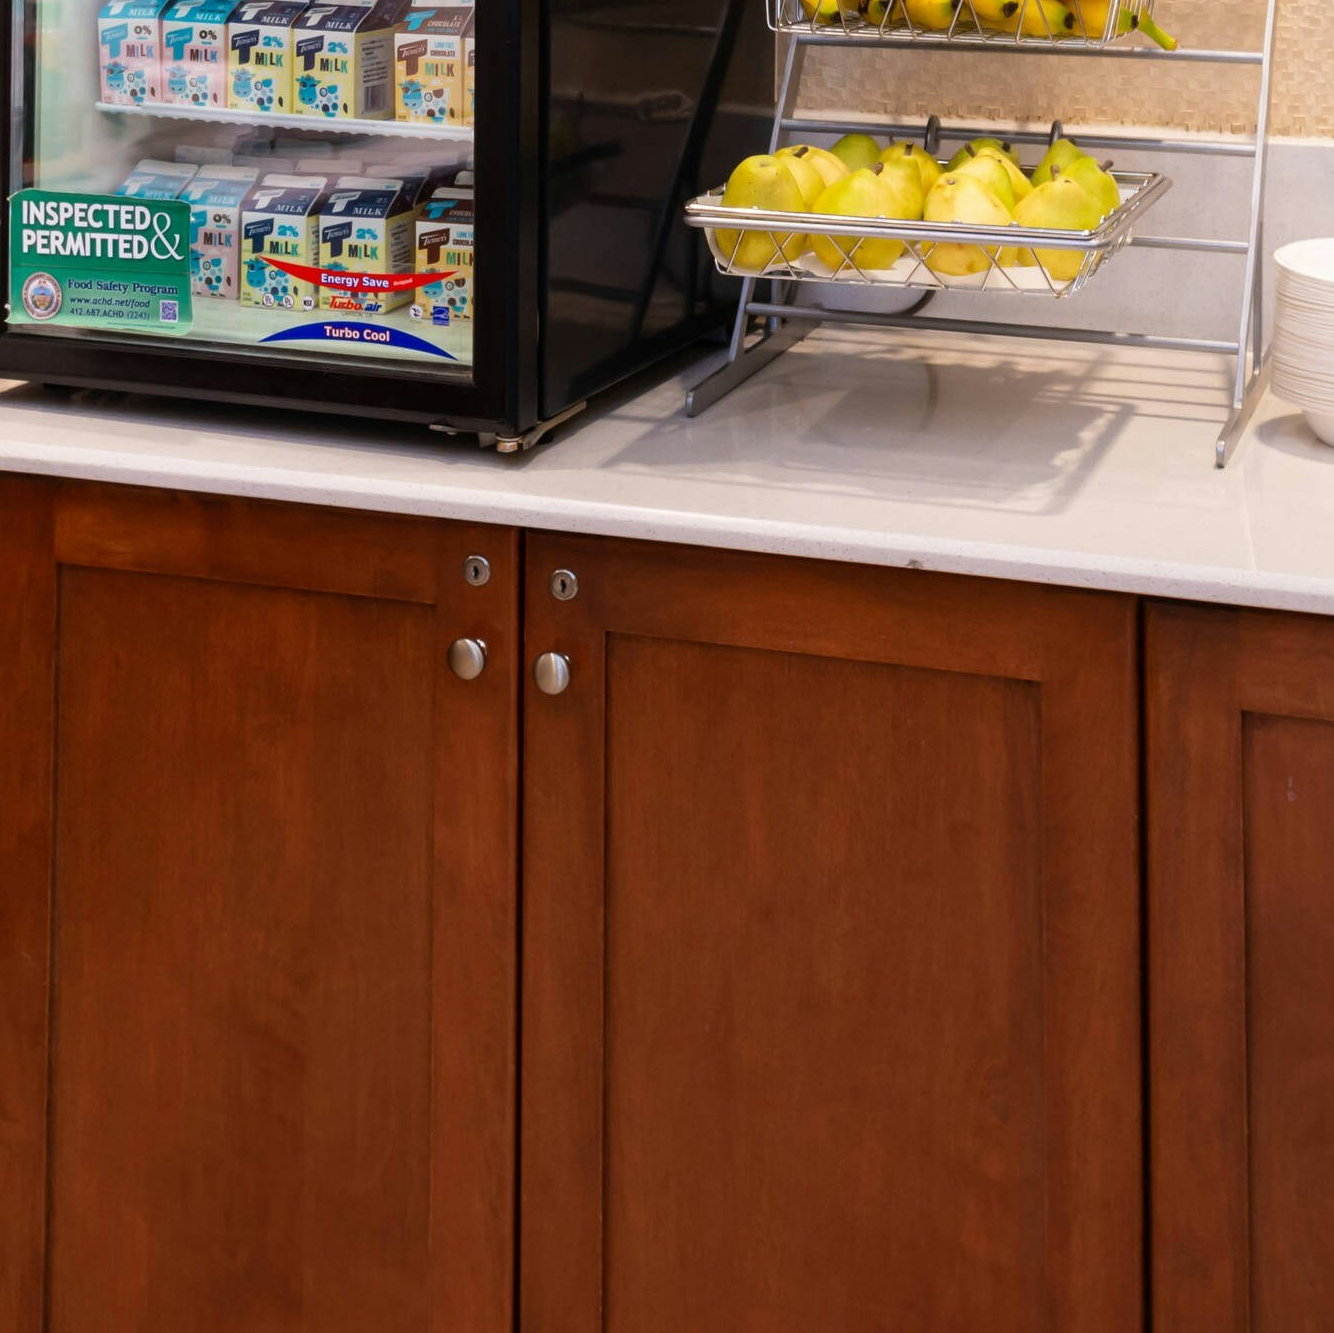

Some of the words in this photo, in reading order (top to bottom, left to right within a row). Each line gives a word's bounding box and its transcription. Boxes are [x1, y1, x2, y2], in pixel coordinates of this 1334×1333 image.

[127, 8, 155, 16] MILK
[194, 13, 221, 21] MILK
[261, 16, 289, 25] MILK
[325, 21, 352, 30] MILK
[427, 20, 461, 28] CHOCOLATE
[134, 25, 152, 35] 0%
[199, 30, 218, 40] 0%
[262, 36, 283, 48] 2%
[327, 42, 348, 54] 2%
[126, 44, 154, 58] MILK
[190, 48, 218, 63] MILK
[254, 52, 283, 67] MILK
[320, 58, 348, 73] MILK
[424, 62, 455, 77] MILK
[209, 195, 237, 205] MILK
[275, 204, 303, 213] MILK
[352, 207, 382, 216] MILK
[213, 213, 232, 224] 0%
[22, 200, 151, 230] INSPECTED
[150, 212, 185, 261] &
[277, 224, 299, 237] 2%
[355, 228, 378, 240] 2%
[22, 229, 149, 260] PERMITTED
[203, 232, 232, 247] MILK
[269, 241, 299, 257] MILK
[348, 244, 378, 260] MILK
[321, 273, 359, 287] Energy
[362, 275, 389, 288] Save
[68, 279, 93, 290] Food
[96, 280, 129, 295] Safety
[132, 283, 178, 297] Program
[69, 296, 151, 309] www.achd.net/food
[329, 295, 362, 311] Turbo
[365, 302, 382, 312] air
[70, 307, 124, 318] 412.687.ACHD
[126, 310, 151, 321] (2243)
[324, 326, 360, 339] Turbo
[363, 329, 390, 342] Cool
